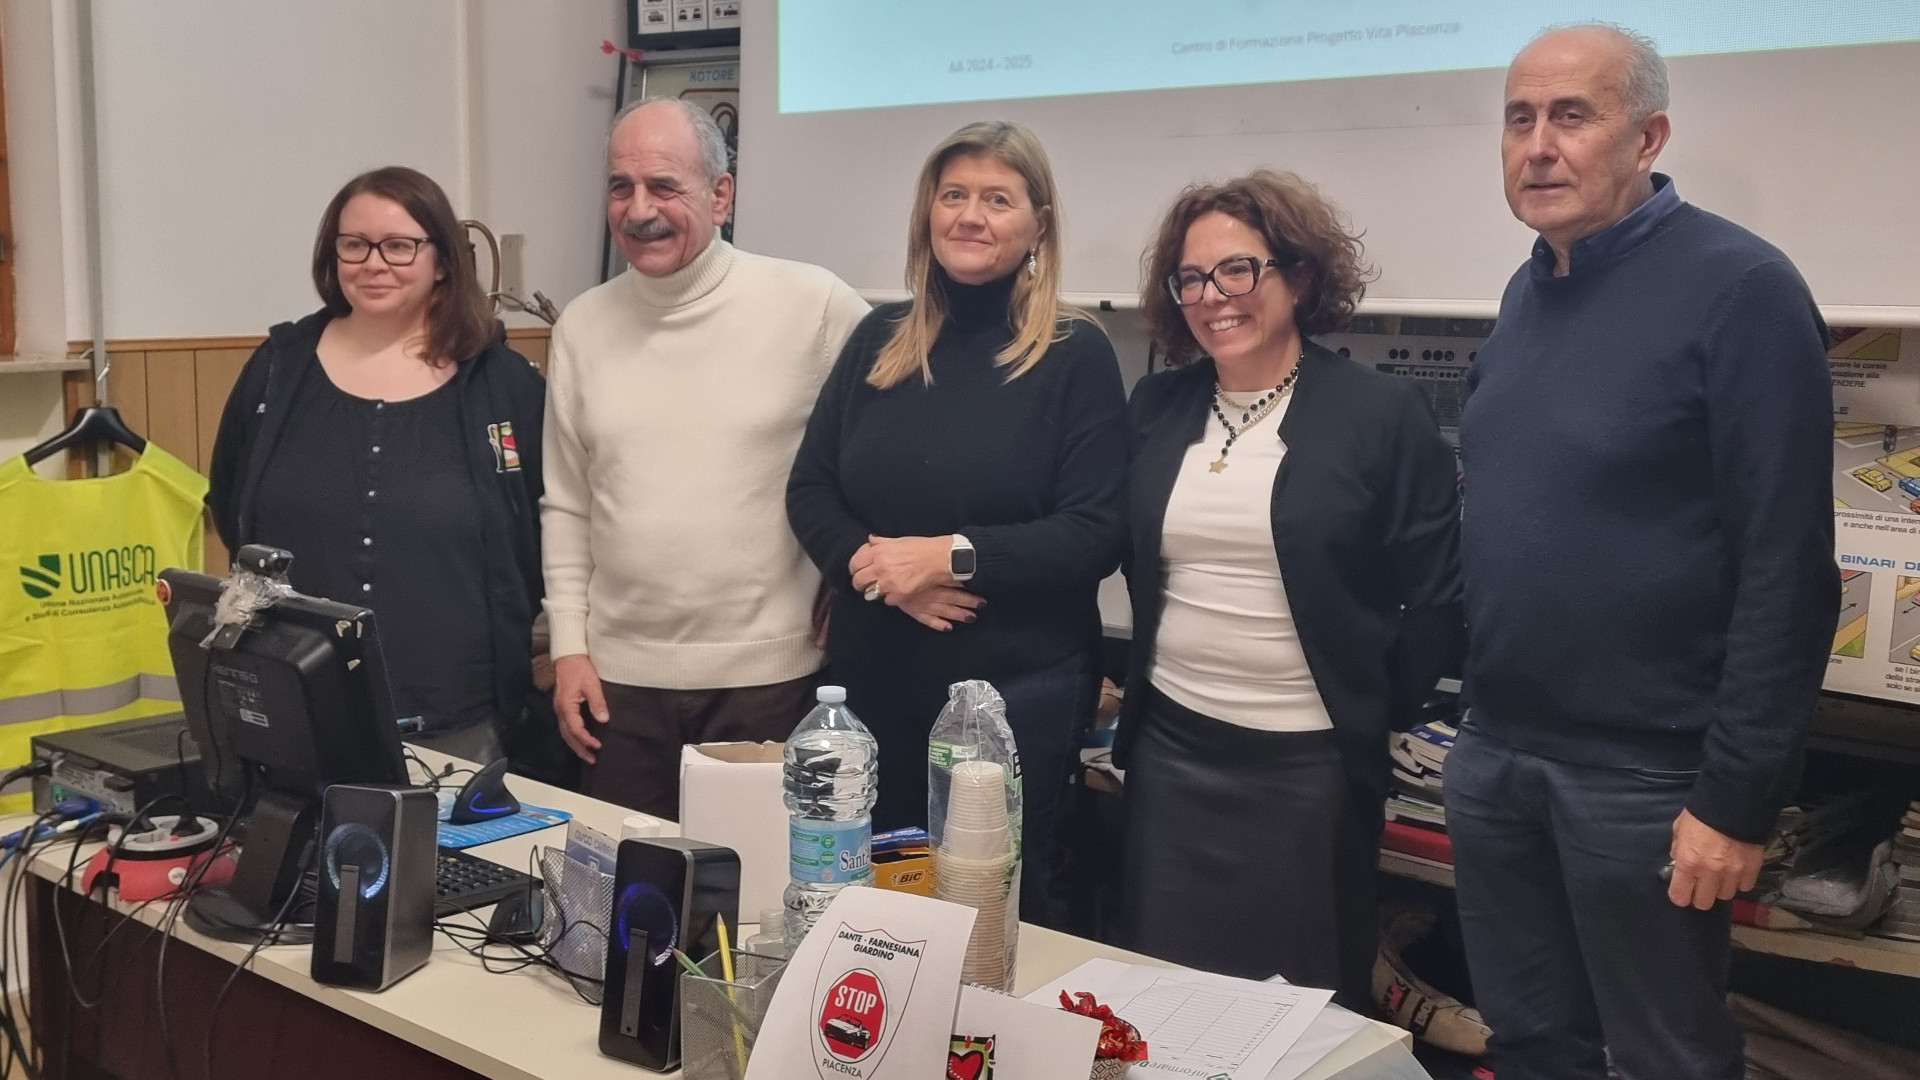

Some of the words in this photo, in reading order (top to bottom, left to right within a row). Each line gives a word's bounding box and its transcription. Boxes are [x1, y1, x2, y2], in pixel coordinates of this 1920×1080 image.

[690, 69, 734, 82] MOTORE
[1850, 522, 1873, 530] anche
[69, 544, 155, 594] UNASCA
[1841, 554, 1896, 568] BINARI
[838, 931, 863, 943] DANTE
[868, 937, 920, 958] FARNESIANA
[853, 944, 895, 961] GIARDINO
[834, 984, 878, 1015] STOP
[822, 1058, 863, 1079] PIACENZA
